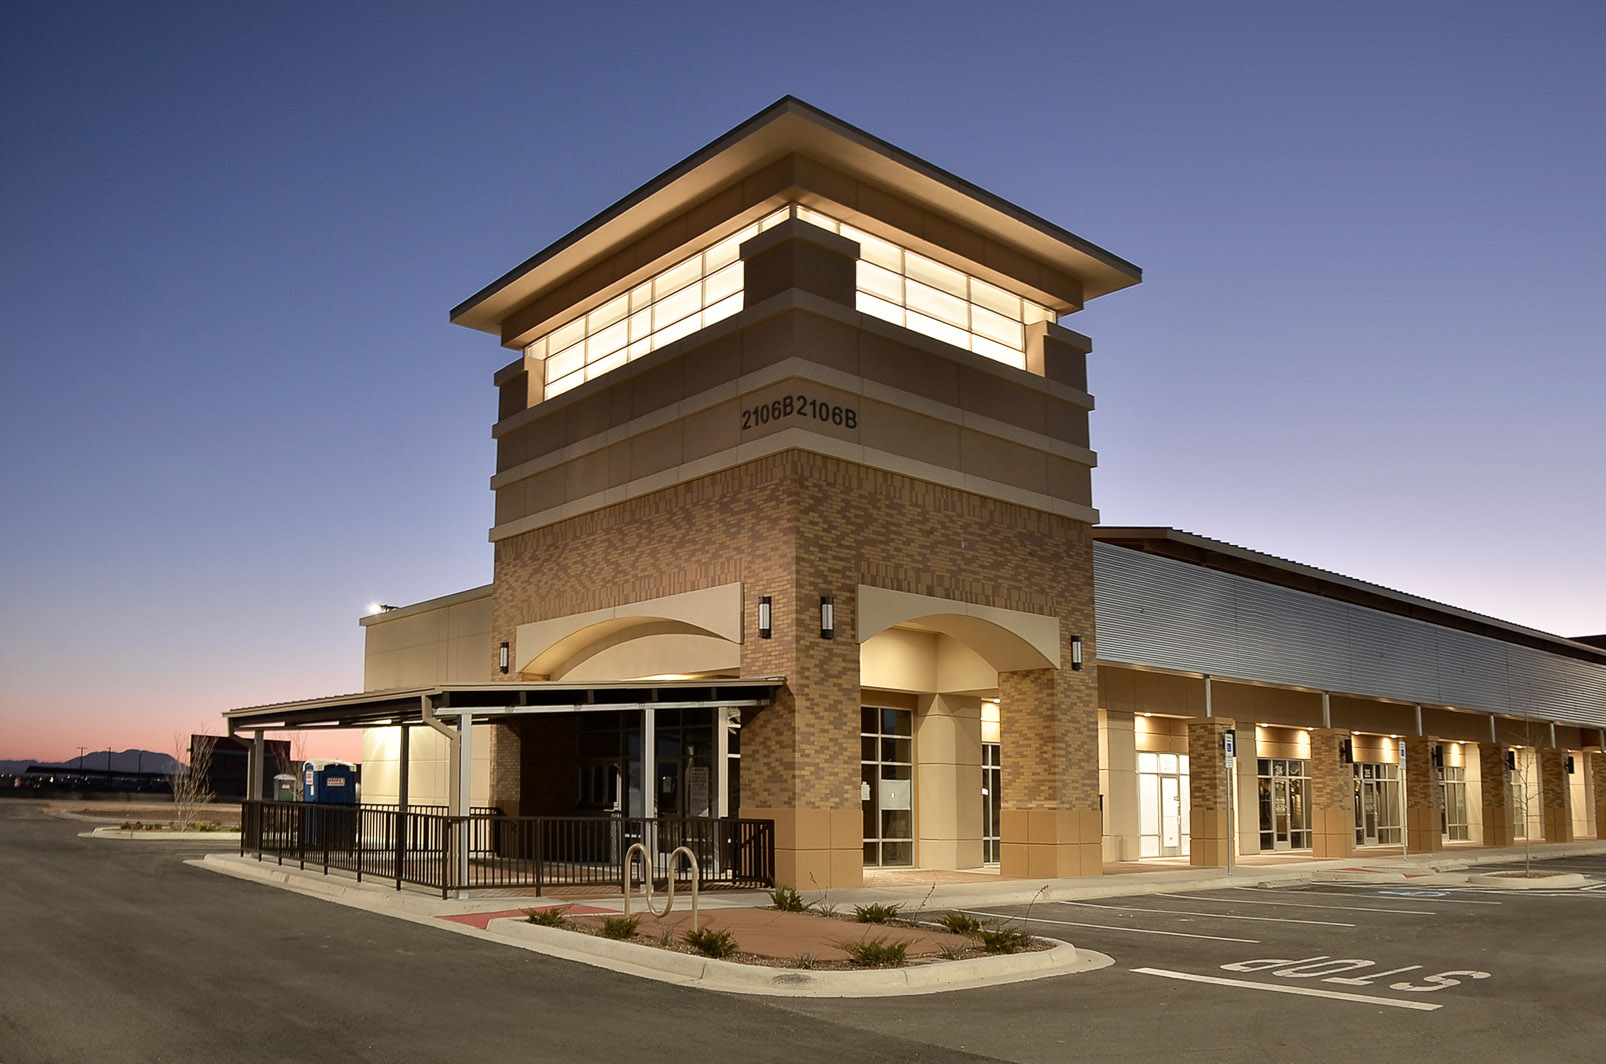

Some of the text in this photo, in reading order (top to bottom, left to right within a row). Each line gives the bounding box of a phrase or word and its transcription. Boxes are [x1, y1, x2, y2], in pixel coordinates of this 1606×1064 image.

[742, 395, 794, 430] 2106B
[796, 395, 857, 429] 2106B
[1219, 956, 1492, 992] STOP
